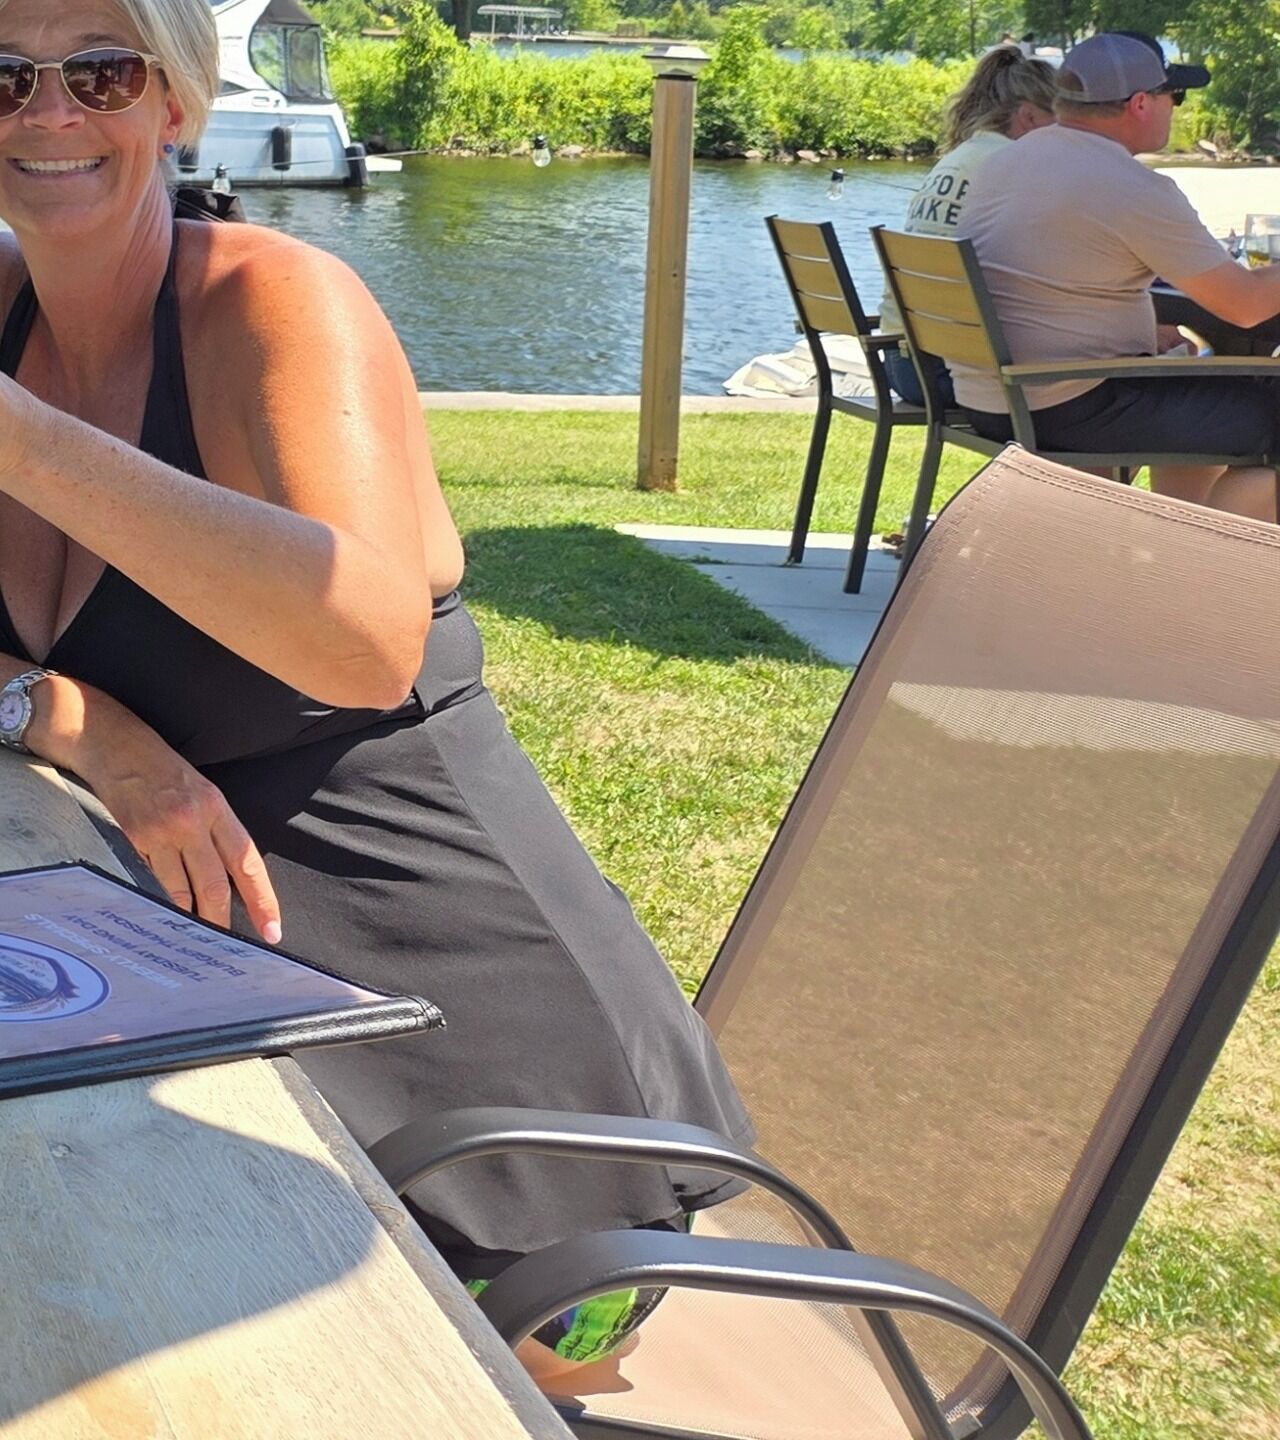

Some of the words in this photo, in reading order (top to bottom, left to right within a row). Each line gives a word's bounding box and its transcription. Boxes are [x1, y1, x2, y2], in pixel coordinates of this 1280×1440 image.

[23, 913, 110, 954] SPECIALS
[62, 914, 97, 930] DAY
[95, 910, 177, 948] THURSDAY
[93, 929, 138, 950] WING
[105, 953, 182, 989] WEEKLY
[135, 949, 209, 982] TUESDAY
[175, 947, 247, 976] BURGER
